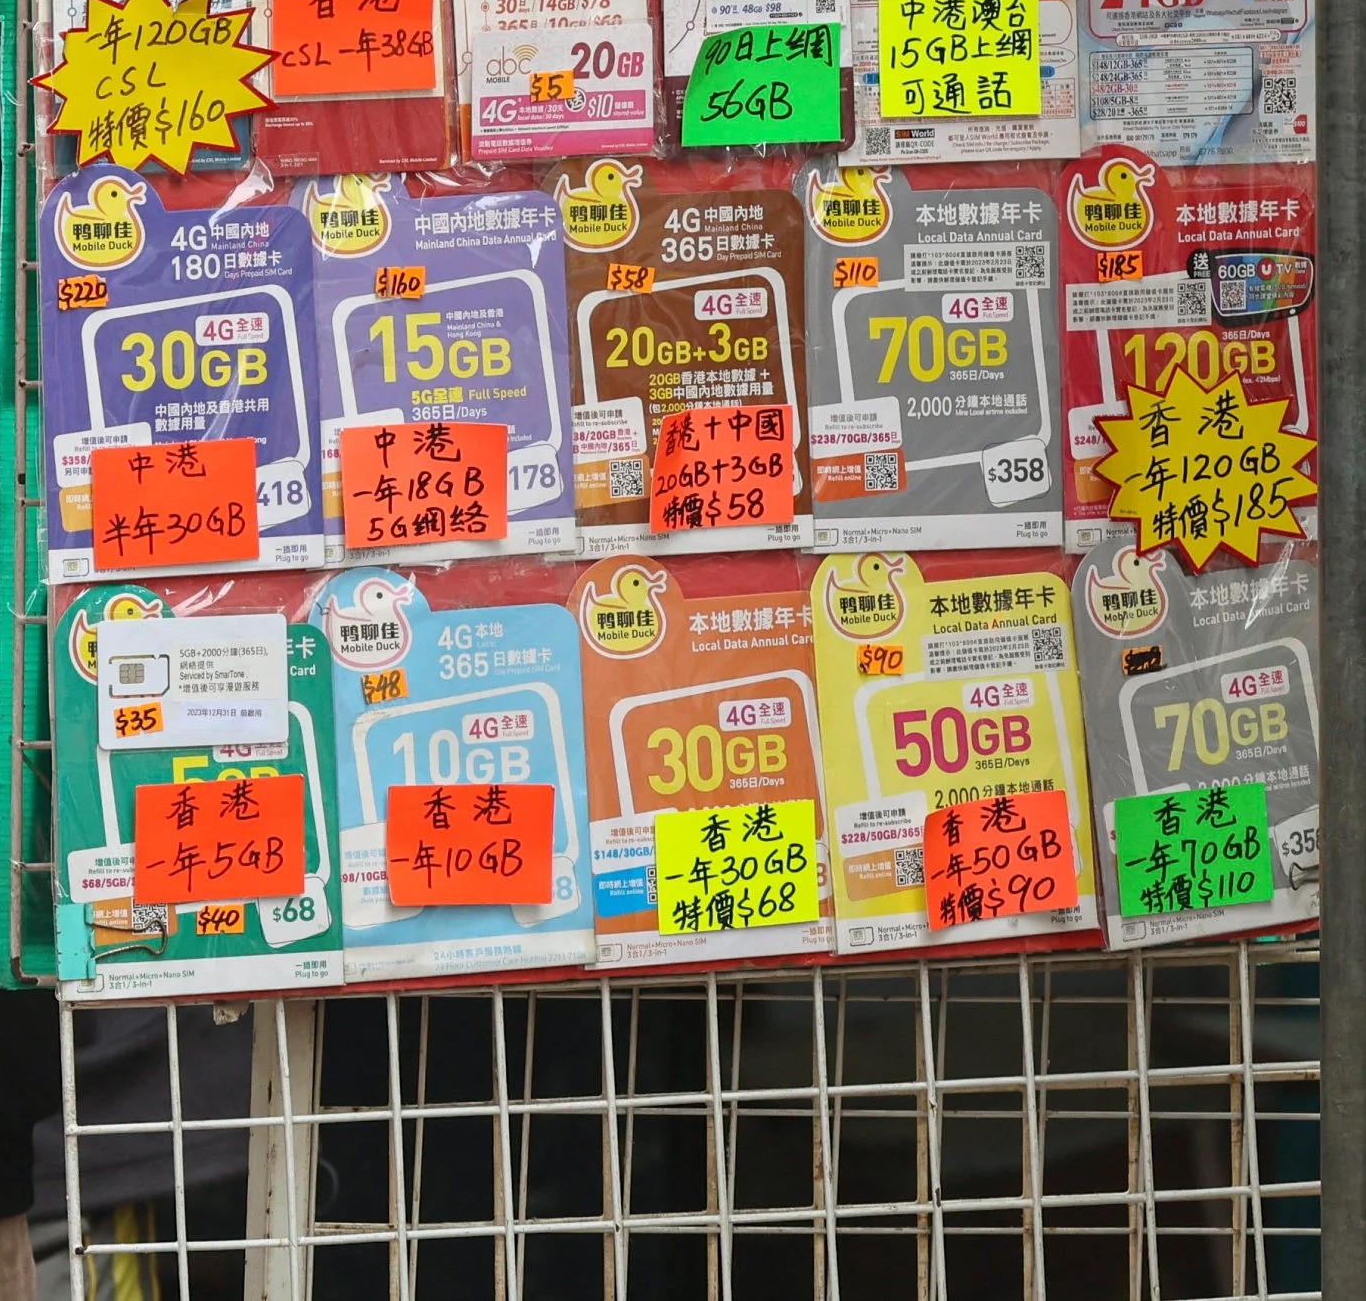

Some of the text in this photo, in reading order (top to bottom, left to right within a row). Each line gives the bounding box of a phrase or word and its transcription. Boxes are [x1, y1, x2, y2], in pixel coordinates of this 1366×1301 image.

[571, 41, 644, 80] 20GB
[701, 82, 795, 122] 56GB
[916, 203, 1042, 227] 本地數據年卡
[73, 240, 134, 252] Mobile Duck
[171, 229, 207, 252] 4G
[918, 230, 1042, 242] Local Data Annual Card
[1098, 252, 1139, 279] $185
[121, 330, 268, 392] 30GB
[369, 313, 512, 384] 15GB
[606, 322, 768, 368] 20GB+3GB
[869, 315, 1008, 384] 70GB
[988, 459, 1044, 483] $358
[115, 707, 157, 735] $35
[393, 730, 531, 785] 10GB
[648, 726, 787, 795] 30GB
[894, 706, 1032, 777] 50GB
[166, 789, 260, 830] 香港
[700, 806, 783, 853] 香港
[273, 897, 316, 923] $68
